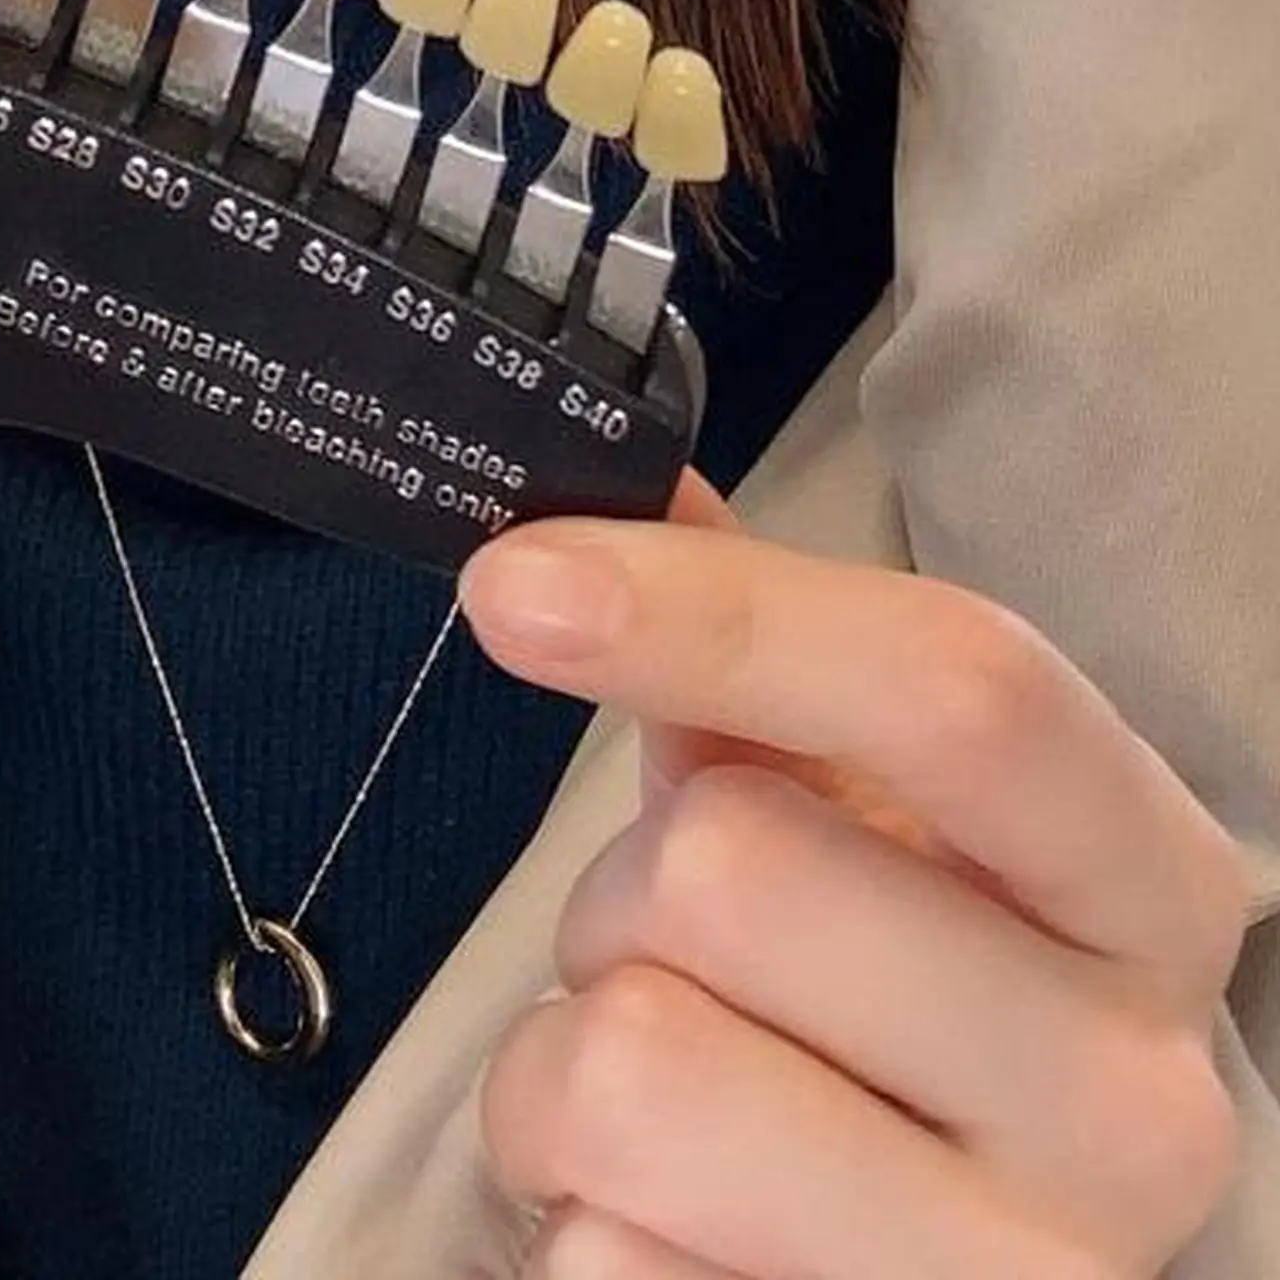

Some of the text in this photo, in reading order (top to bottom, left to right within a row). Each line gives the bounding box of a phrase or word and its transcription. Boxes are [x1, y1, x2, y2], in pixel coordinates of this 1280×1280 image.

[25, 258, 530, 490] For comparing teeth shades
[28, 117, 100, 169] S28
[120, 157, 191, 210] S30
[210, 197, 280, 251] S32
[300, 240, 370, 295] S34
[385, 286, 456, 341] S36
[473, 334, 544, 388] S38
[560, 385, 632, 441] S40
[121, 347, 146, 378] &
[157, 365, 244, 416] after
[250, 398, 426, 500] bleaching
[434, 482, 517, 534] only
